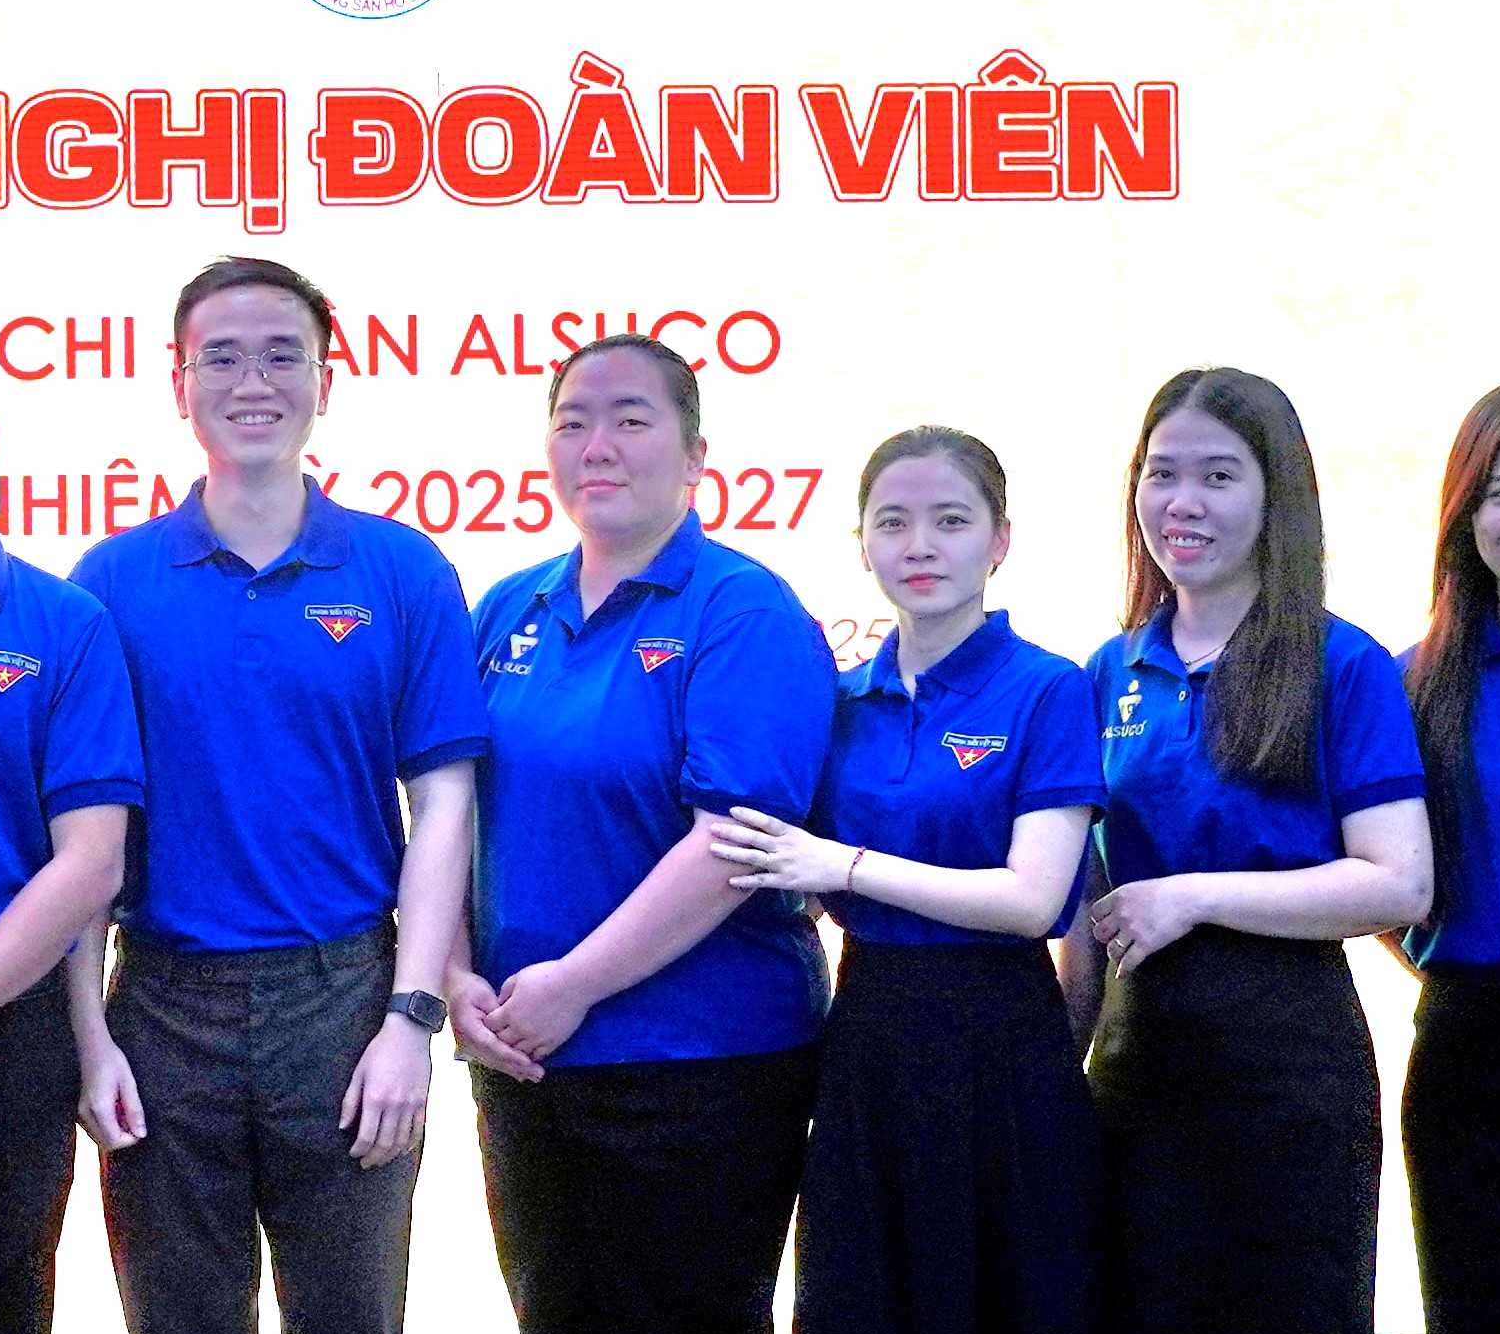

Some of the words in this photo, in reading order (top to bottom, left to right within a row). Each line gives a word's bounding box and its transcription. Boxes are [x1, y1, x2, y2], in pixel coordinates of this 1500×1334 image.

[308, 51, 778, 205] ĐOÀN
[799, 49, 1180, 201] VIÊN
[370, 469, 554, 534] 2025
[688, 467, 824, 532] 027
